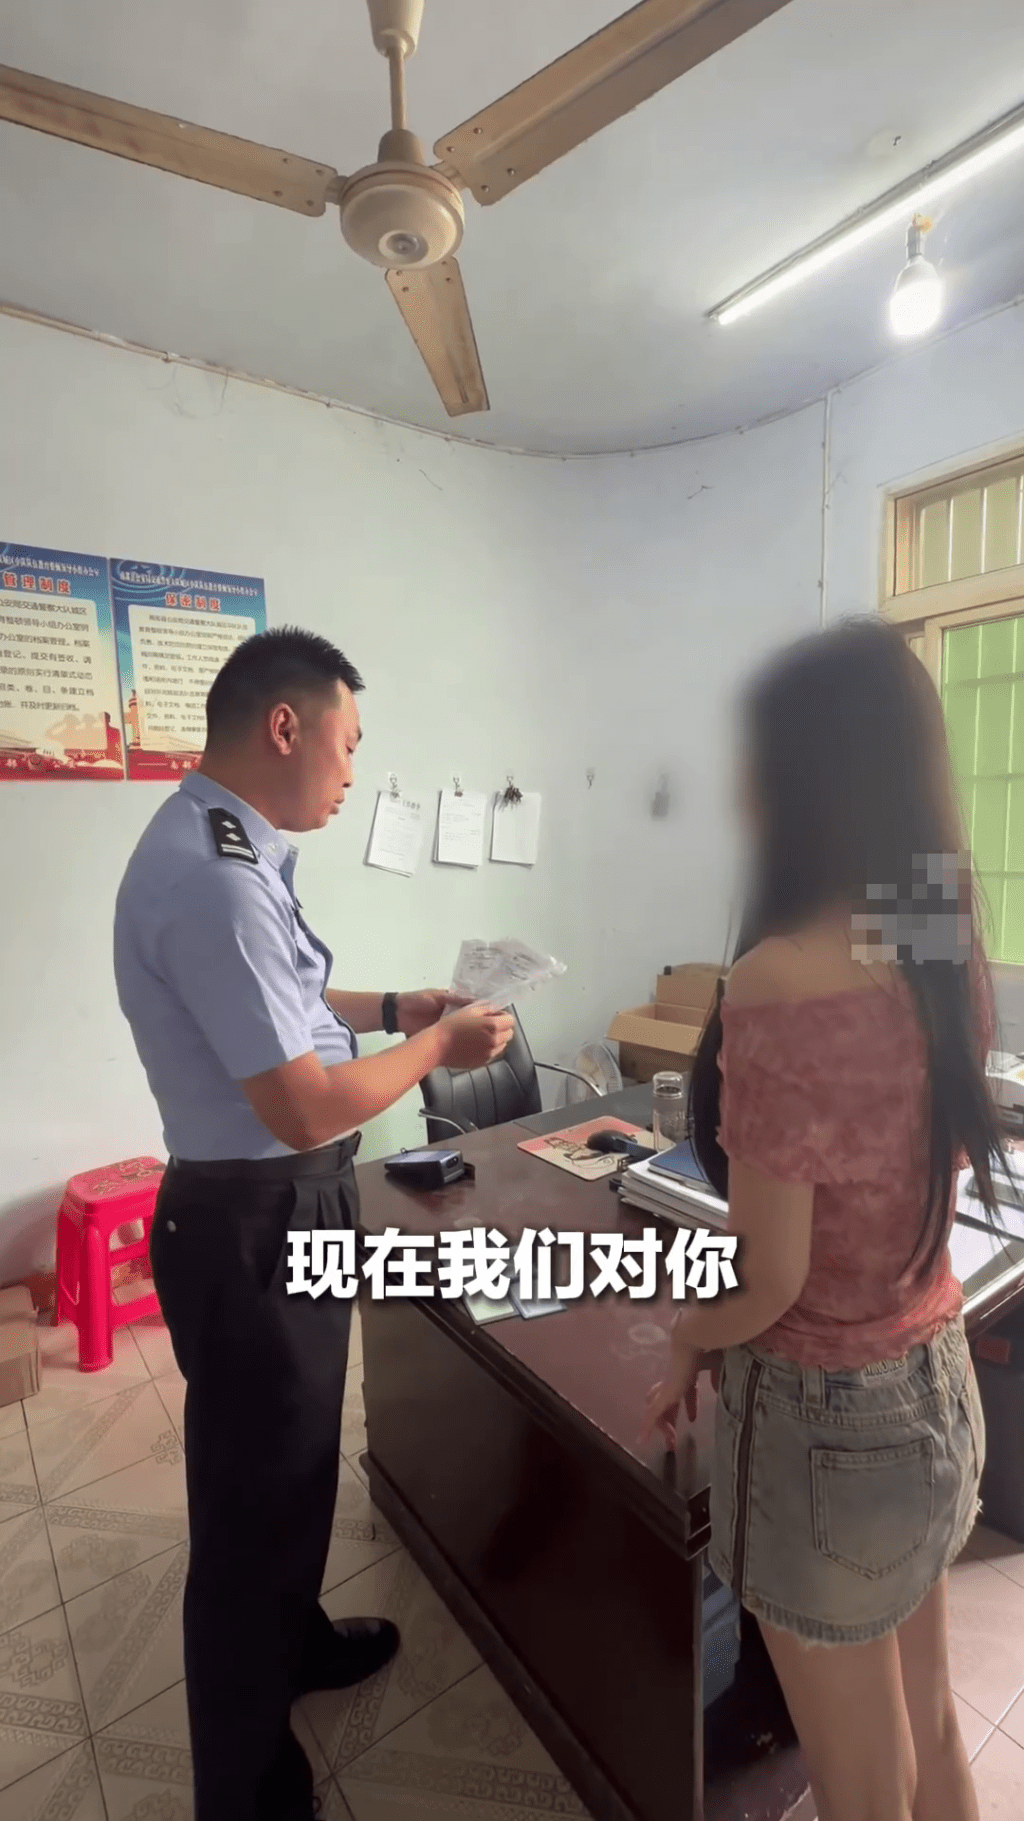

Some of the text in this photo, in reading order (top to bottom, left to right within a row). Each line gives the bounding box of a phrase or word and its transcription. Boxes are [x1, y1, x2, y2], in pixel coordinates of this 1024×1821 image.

[3, 571, 71, 595] 管理制度
[165, 591, 221, 612] 保密制度
